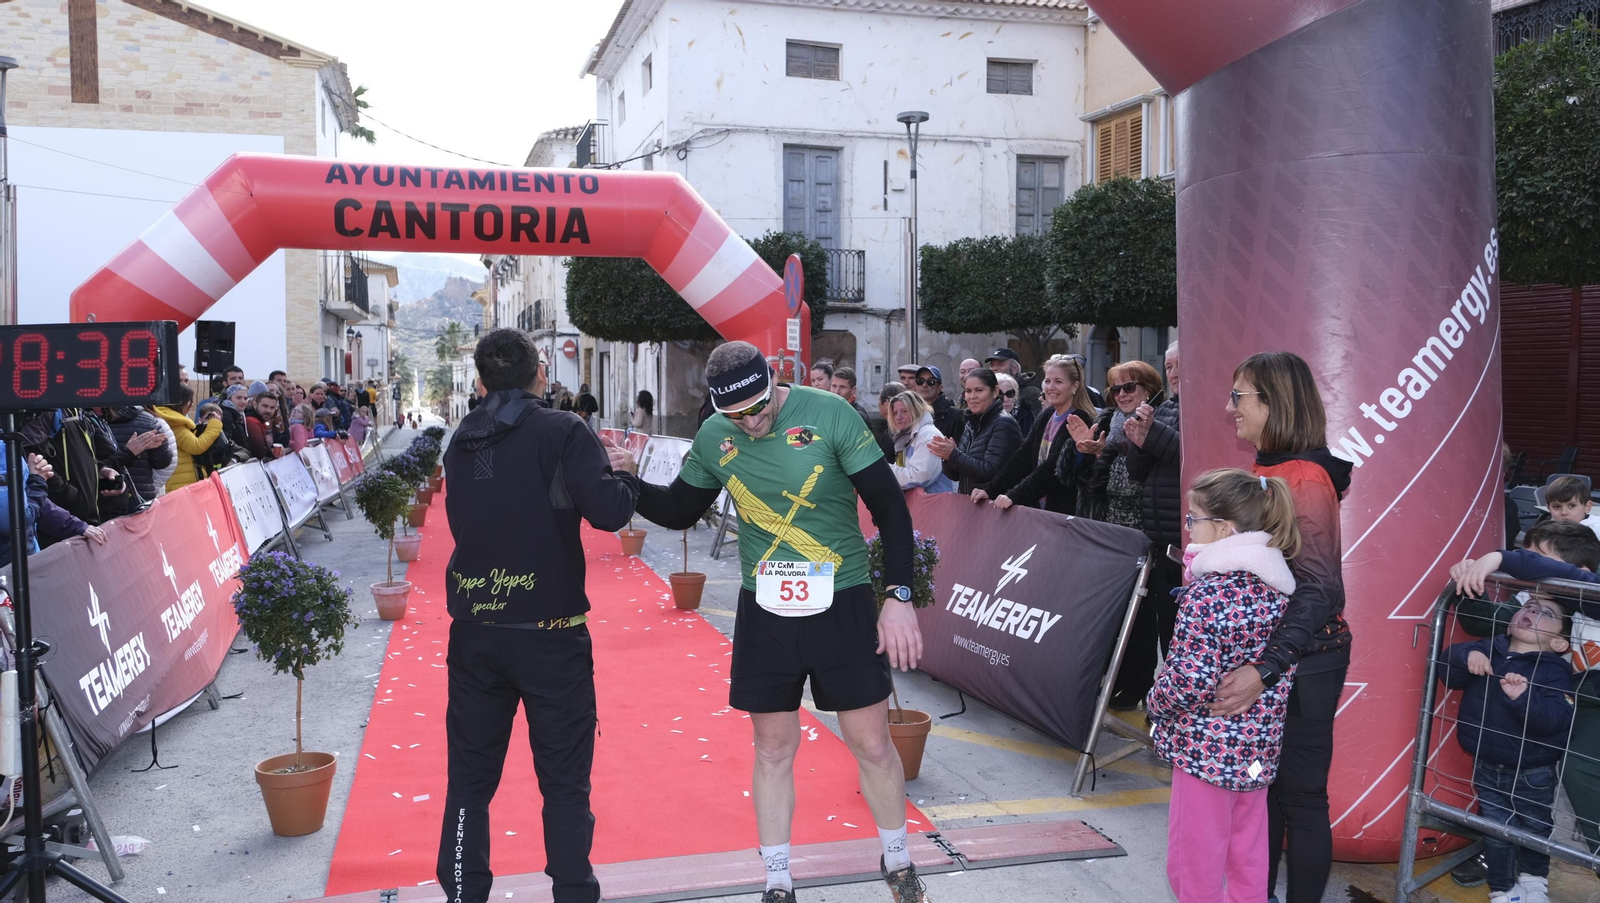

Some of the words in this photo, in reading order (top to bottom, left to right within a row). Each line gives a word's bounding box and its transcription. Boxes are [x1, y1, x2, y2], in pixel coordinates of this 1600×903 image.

[324, 163, 600, 195] AYUNTAMIENTO
[333, 197, 591, 245] CANTORIA
[0, 330, 158, 398] 8:38
[717, 372, 763, 395] LURBEL
[489, 568, 538, 597] Yepes
[774, 569, 806, 577] PÓLVORA
[471, 598, 507, 616] speaker
[779, 580, 809, 601] 53
[160, 579, 206, 643] TEAMERGY
[945, 583, 1063, 644] TEAMERGY
[953, 633, 1011, 667] www.teamergy.es
[78, 631, 151, 716] TEAMERGY
[455, 808, 466, 860] EVENTOS
[454, 862, 462, 882] NON
